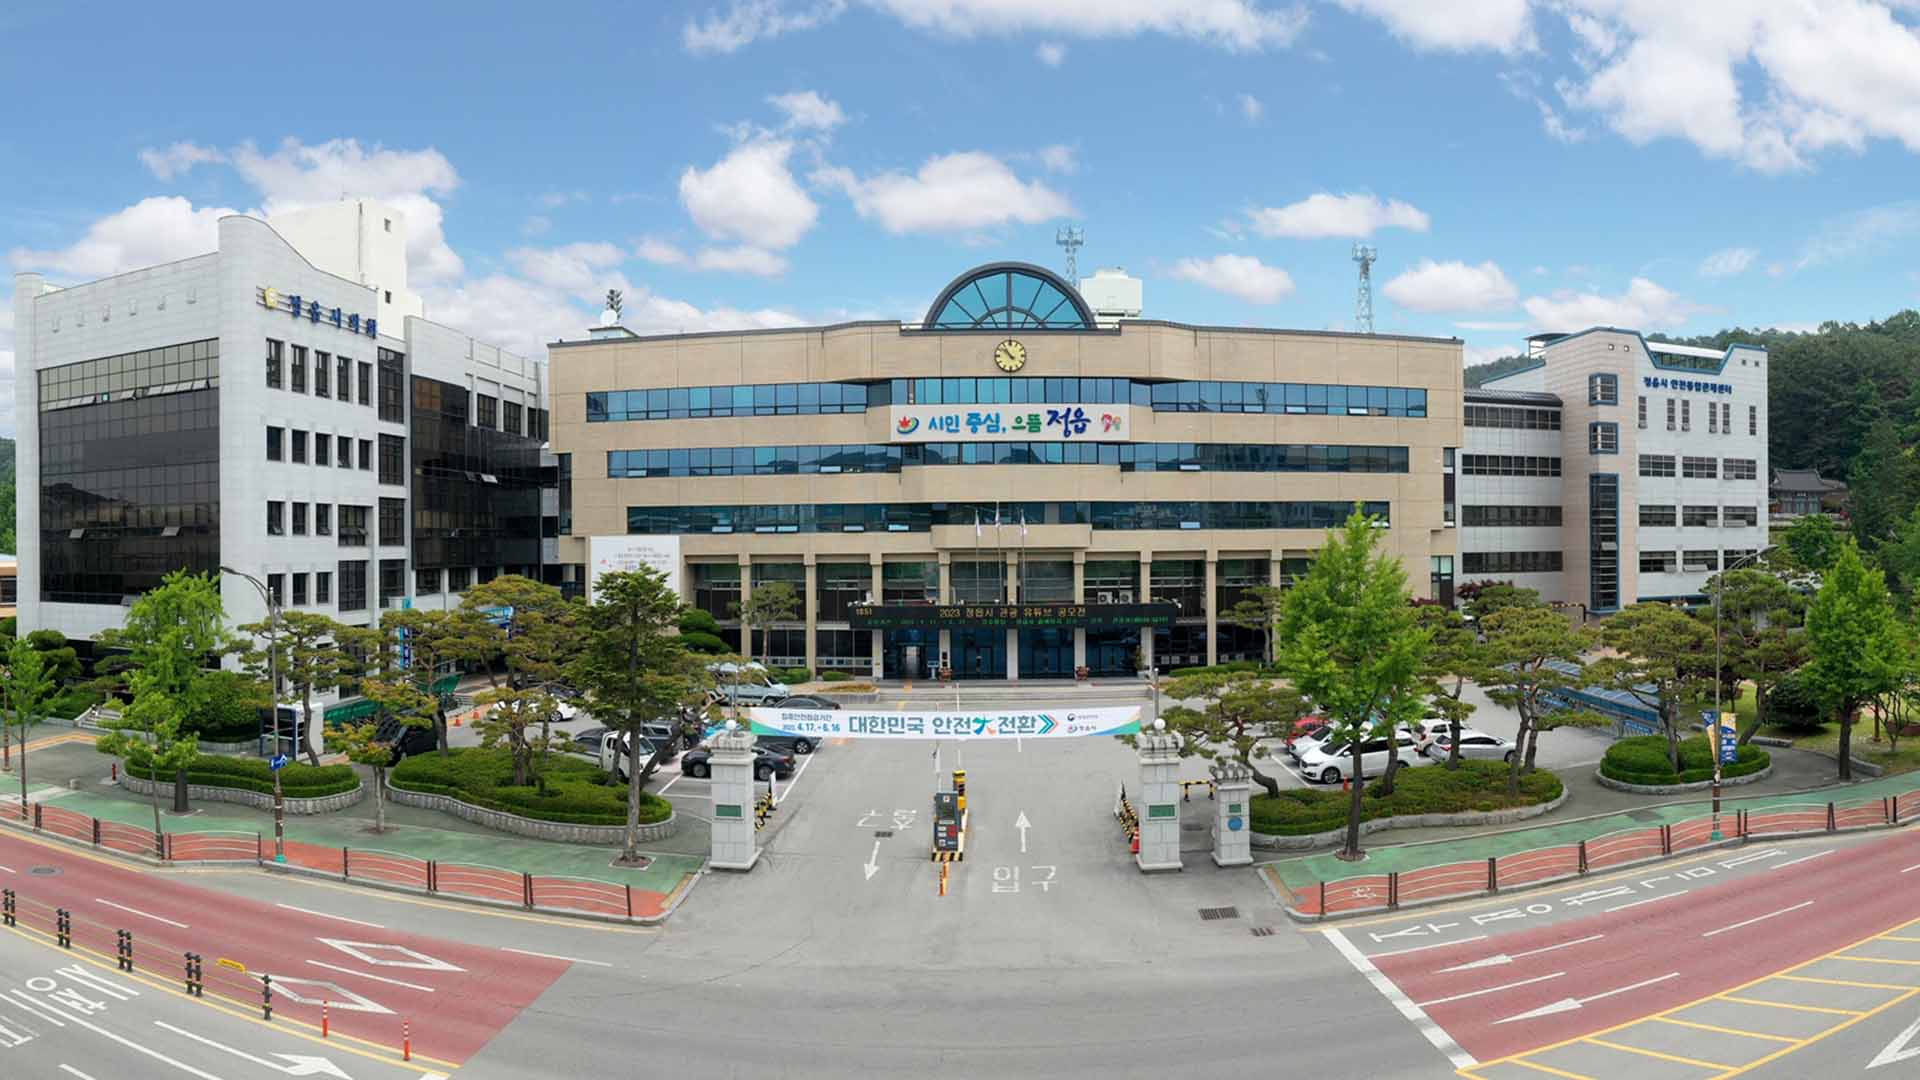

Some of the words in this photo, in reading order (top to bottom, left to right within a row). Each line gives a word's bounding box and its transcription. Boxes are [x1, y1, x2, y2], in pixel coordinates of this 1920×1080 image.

[1643, 376, 1669, 389] 정읍시
[928, 414, 960, 433] 시민
[966, 412, 1007, 434] 중심,
[1011, 414, 1042, 433] 으뜸
[1046, 407, 1092, 438] 정읍
[939, 608, 961, 618] 2023
[966, 607, 994, 618] 정읍시
[1000, 607, 1018, 618] 관광
[1023, 607, 1053, 618] 유튜브
[849, 715, 924, 735] 대한민국
[992, 865, 1057, 893] 입구
